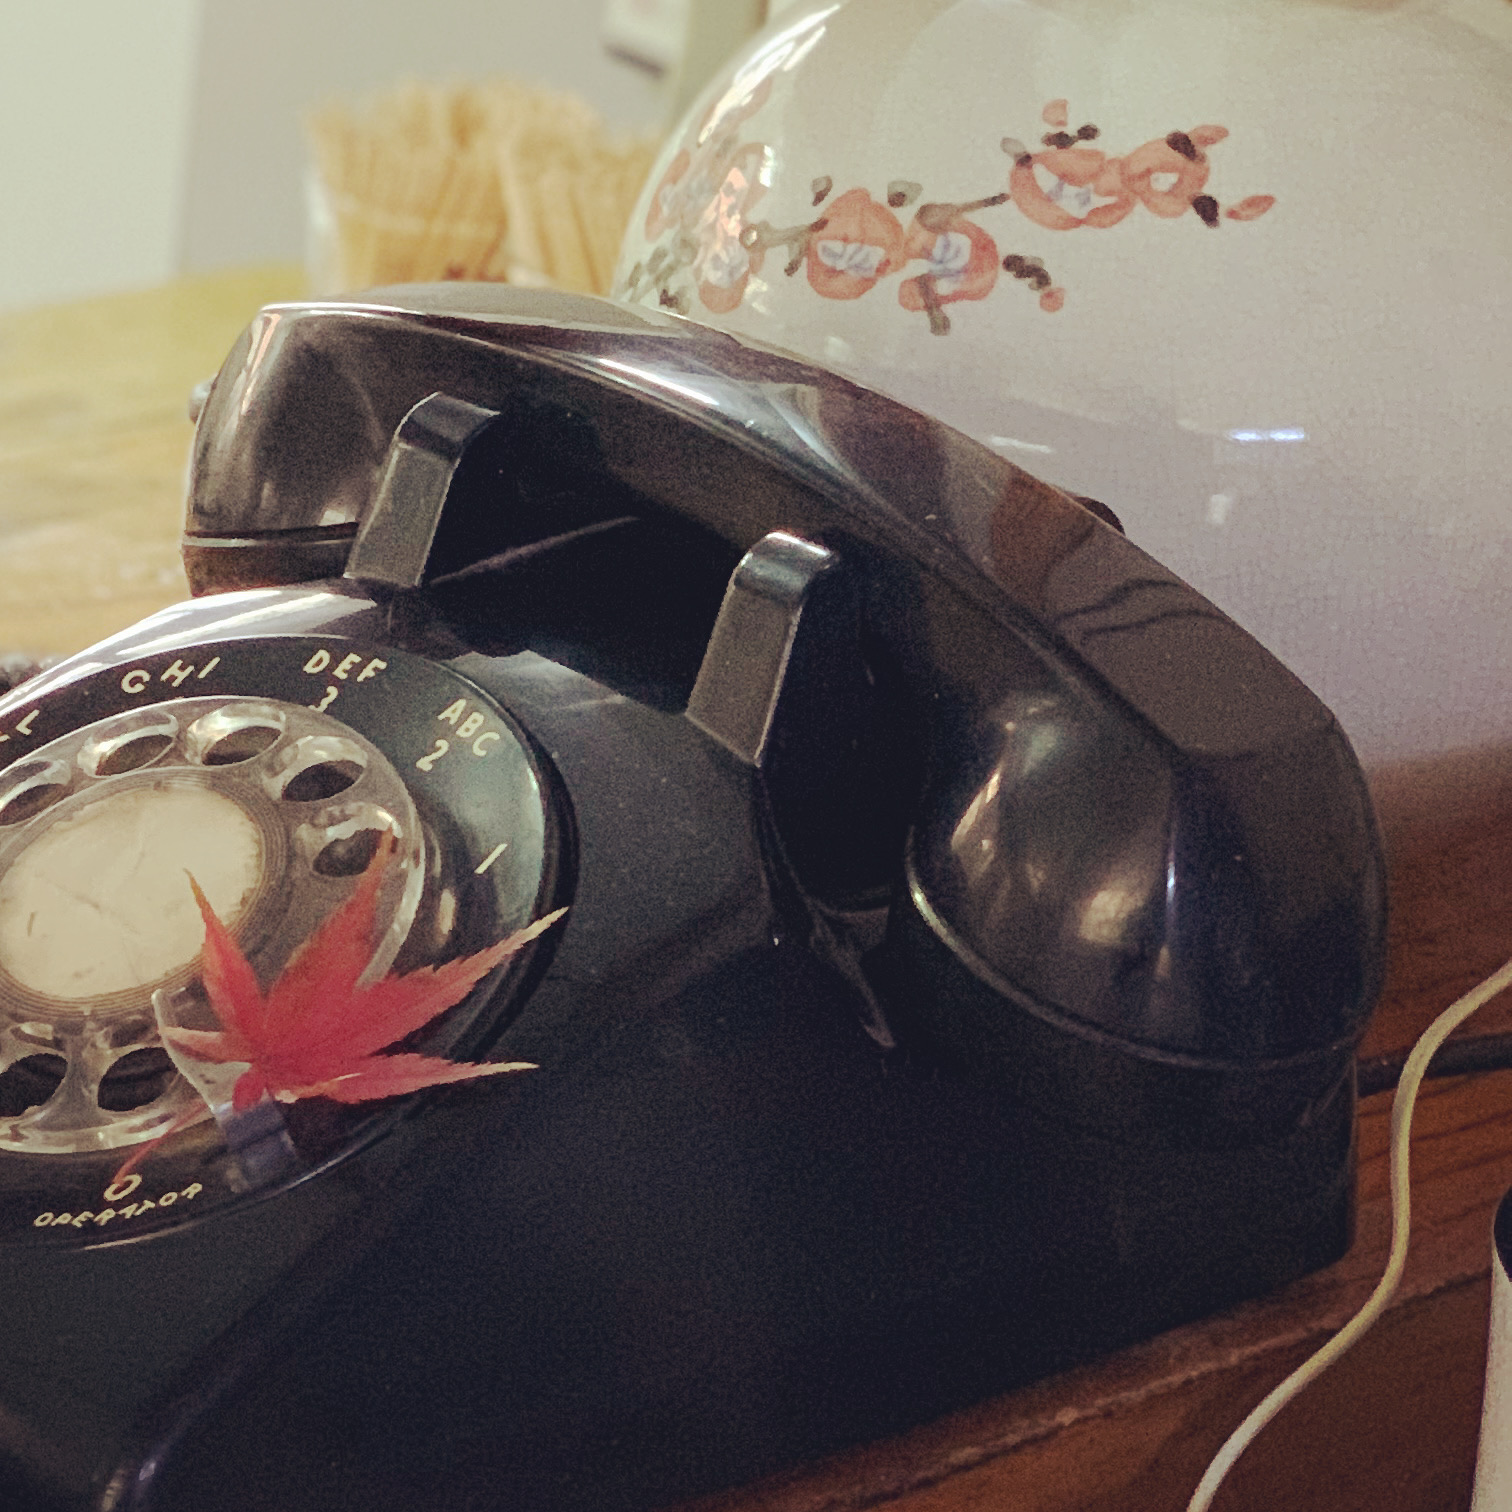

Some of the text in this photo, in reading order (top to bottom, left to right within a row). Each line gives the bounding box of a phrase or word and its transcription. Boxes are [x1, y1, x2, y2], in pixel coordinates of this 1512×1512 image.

[121, 657, 220, 693] GHI
[303, 649, 387, 682] DEF
[437, 698, 500, 756] ABC
[415, 739, 449, 772] 2
[33, 1182, 203, 1228] OPERATOR
